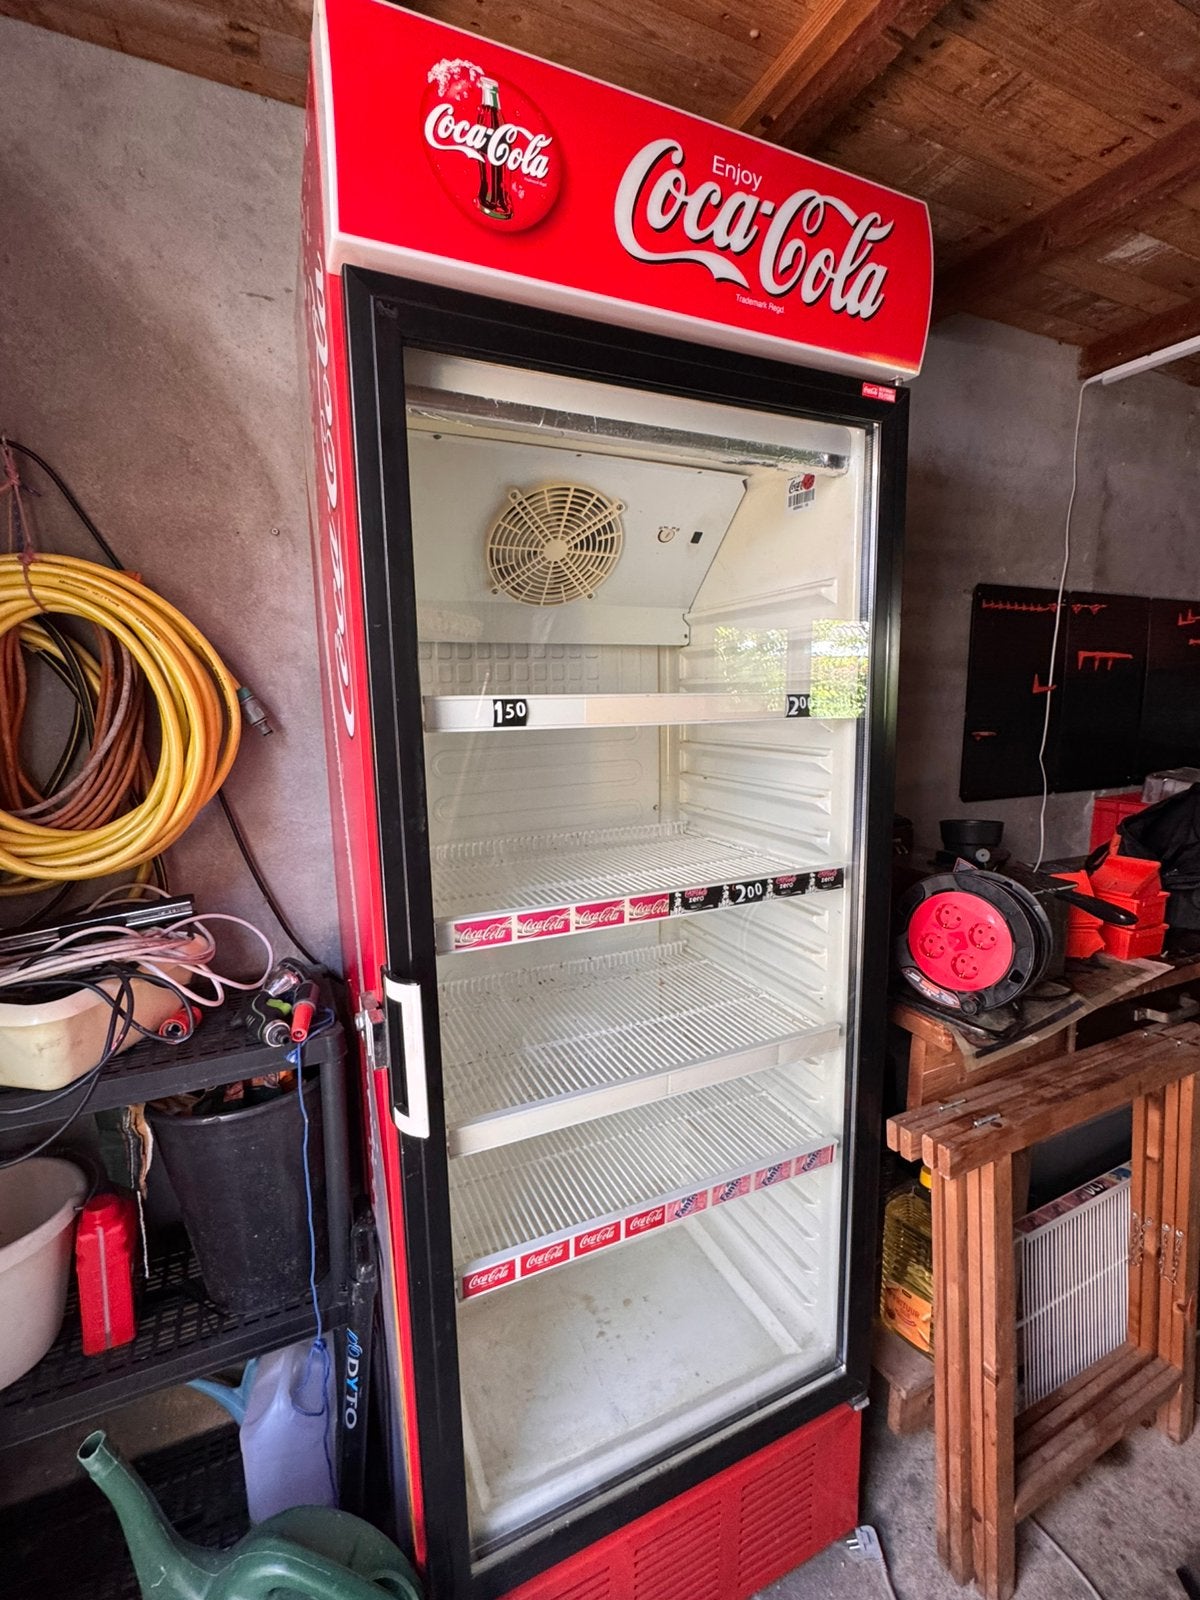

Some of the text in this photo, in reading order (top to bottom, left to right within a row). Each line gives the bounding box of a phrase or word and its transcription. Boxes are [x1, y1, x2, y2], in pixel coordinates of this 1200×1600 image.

[423, 102, 553, 179] Coca-Cola
[711, 154, 763, 191] Enjoy
[614, 138, 894, 319] Coca-Cola
[494, 700, 526, 724] 150
